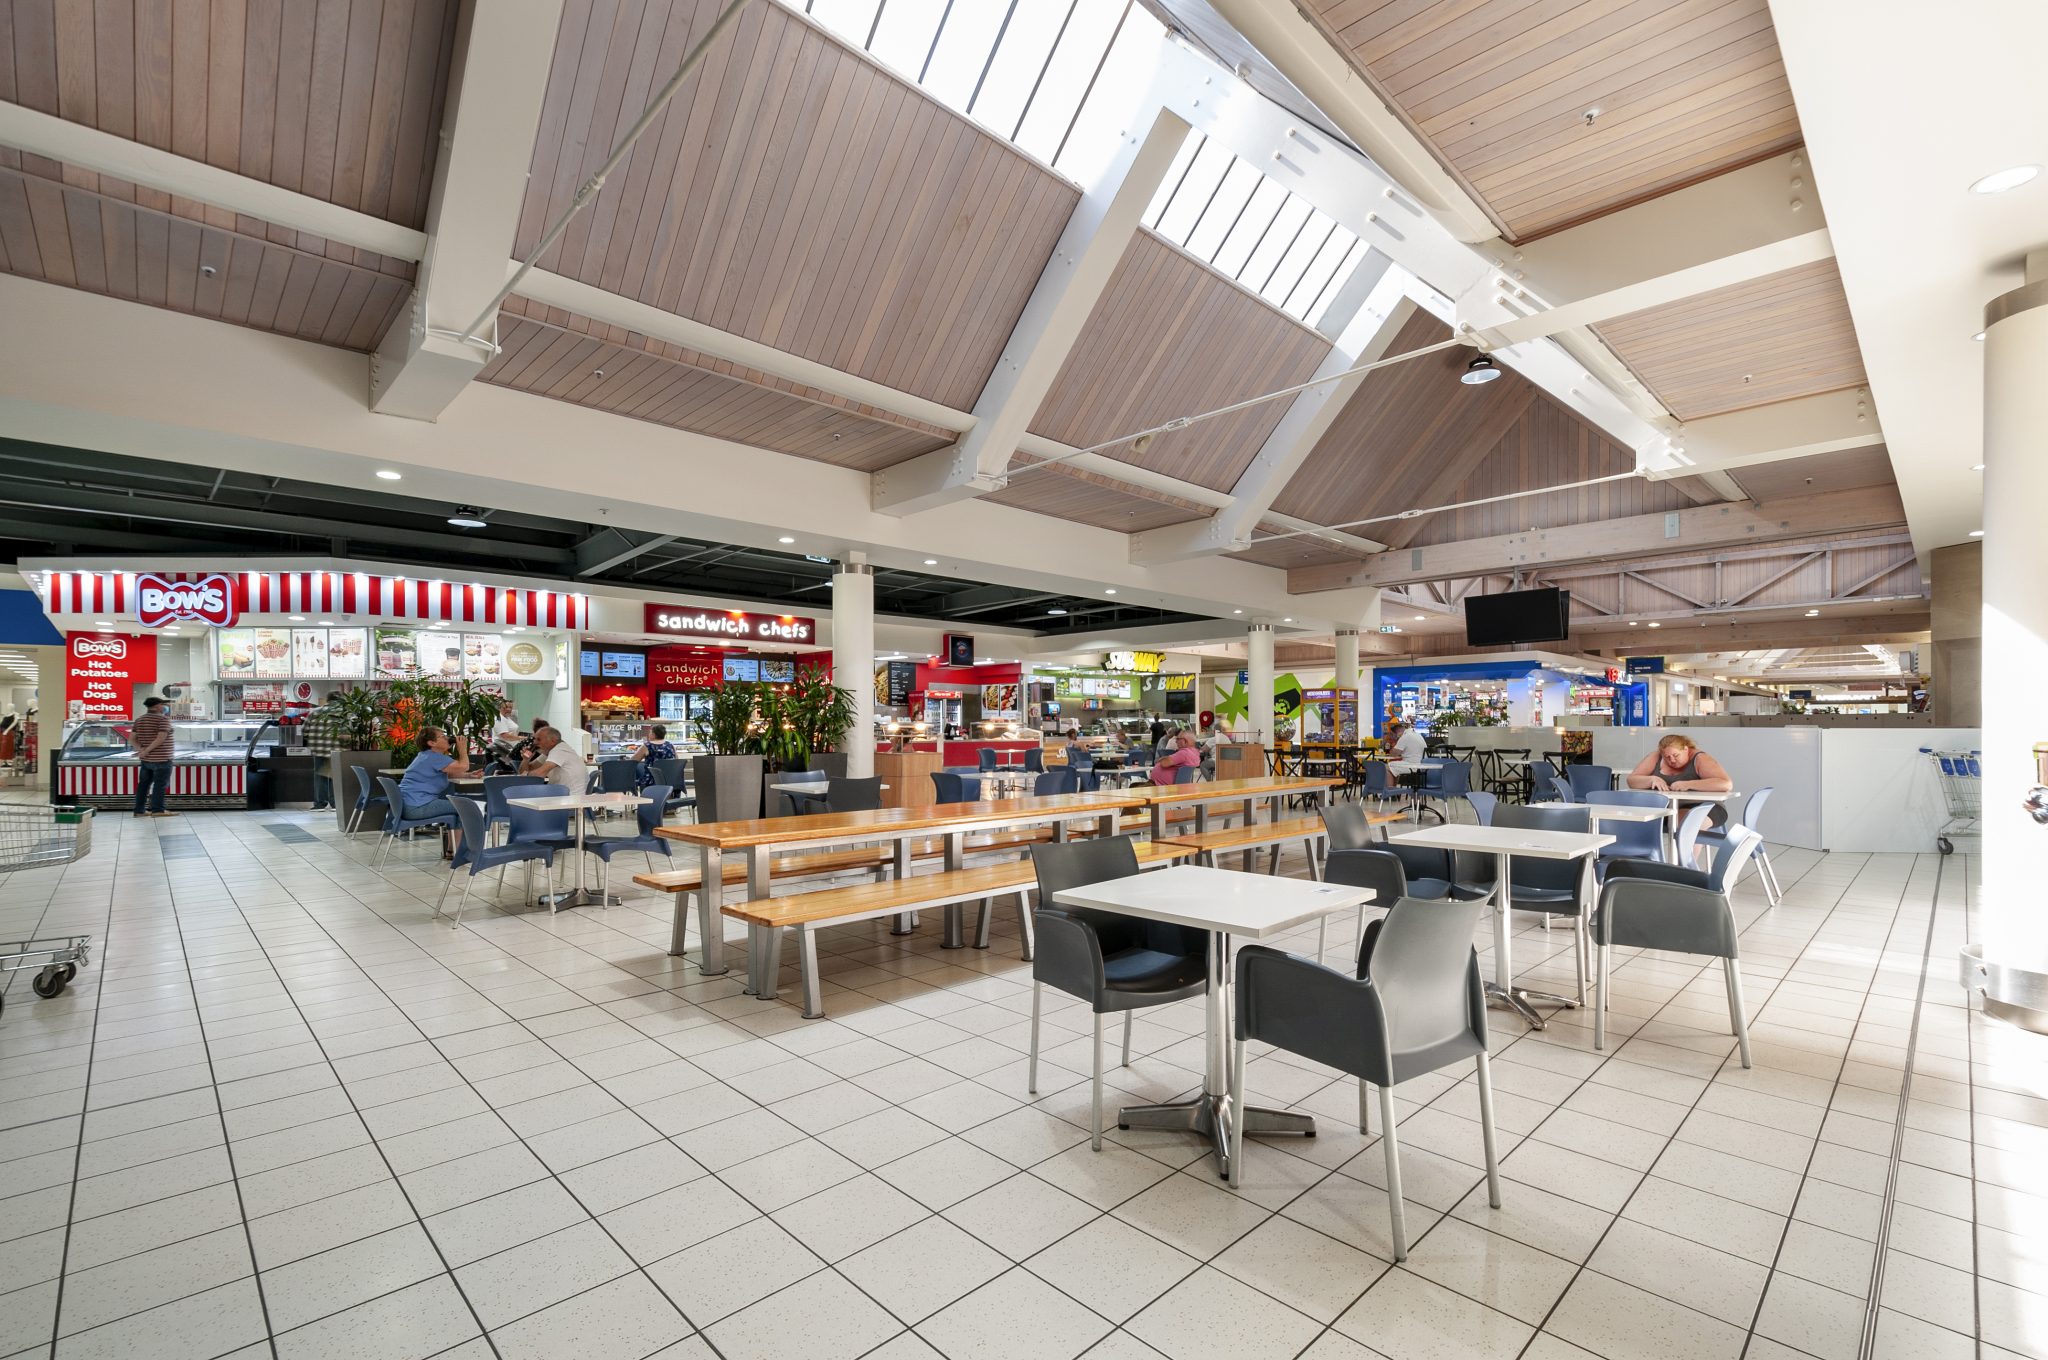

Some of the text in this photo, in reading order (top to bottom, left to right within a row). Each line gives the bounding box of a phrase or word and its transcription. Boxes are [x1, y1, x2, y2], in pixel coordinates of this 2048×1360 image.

[658, 614, 749, 633] sandwich
[88, 660, 112, 669] Hot
[1103, 651, 1166, 673] SUBWAY
[71, 668, 129, 678] Potatoes
[655, 663, 718, 675] sandwich
[88, 682, 112, 690] Hot
[1142, 674, 1195, 692] SBWAY
[83, 690, 117, 700] Dogs
